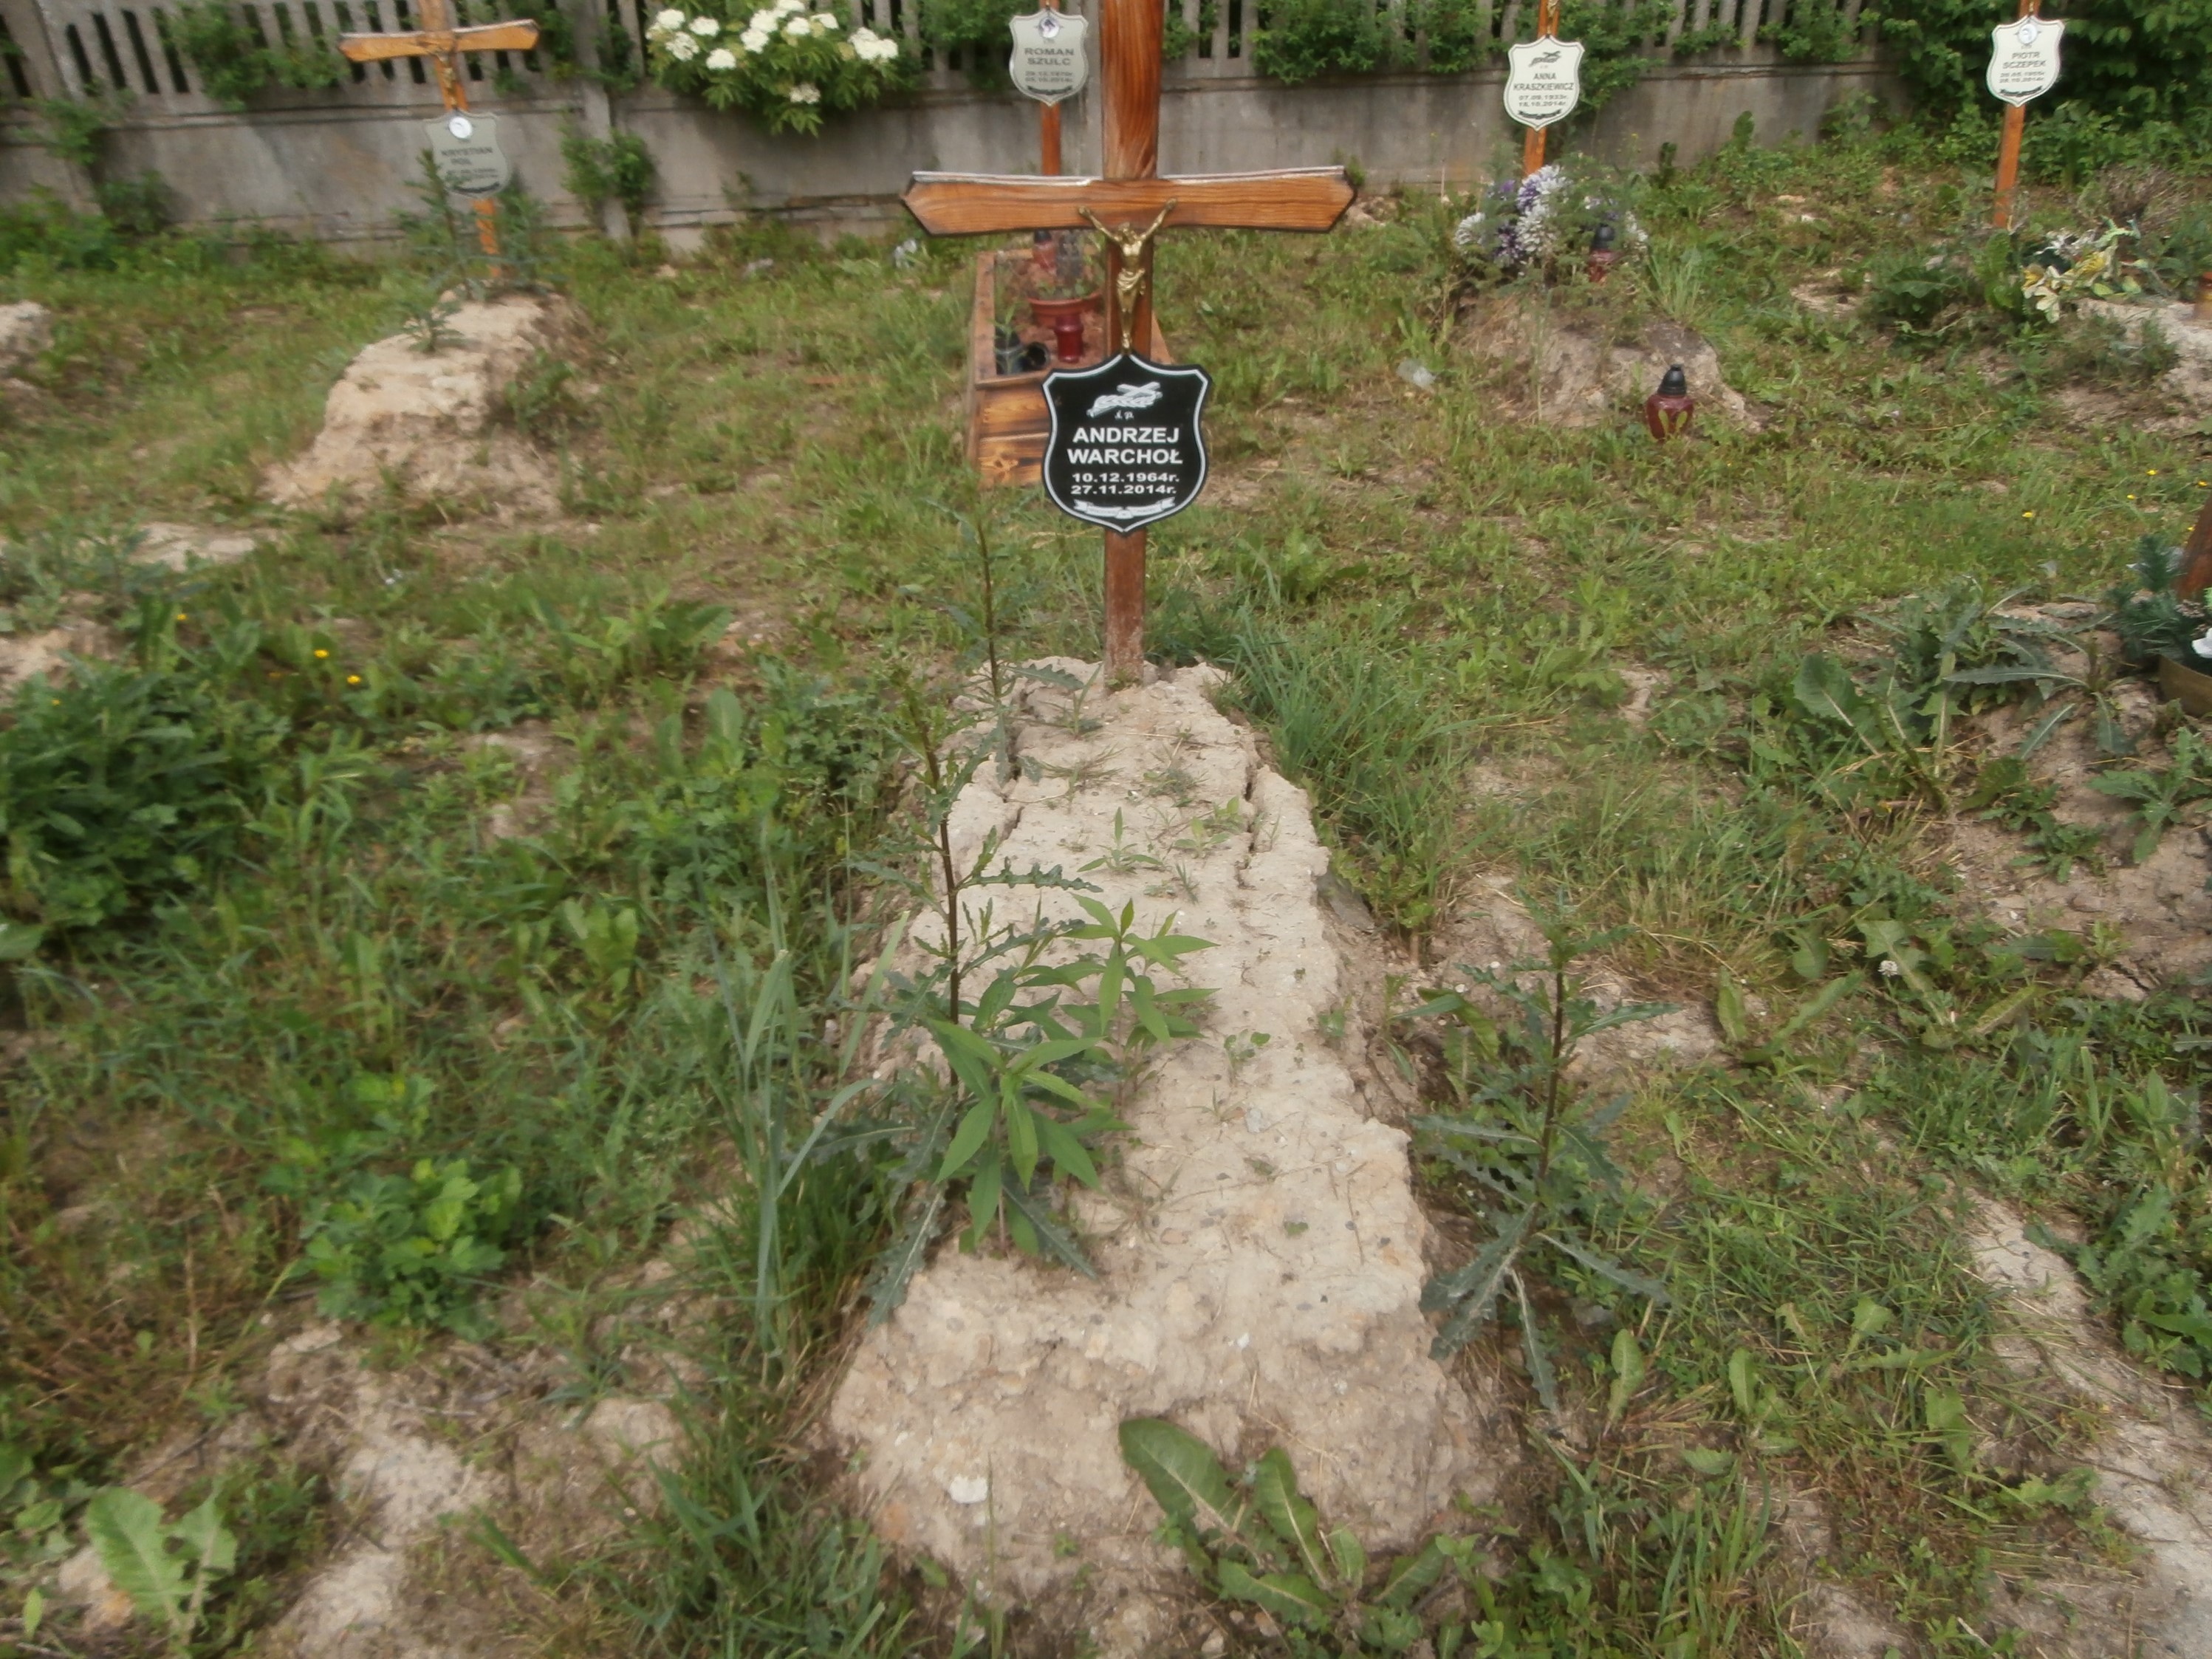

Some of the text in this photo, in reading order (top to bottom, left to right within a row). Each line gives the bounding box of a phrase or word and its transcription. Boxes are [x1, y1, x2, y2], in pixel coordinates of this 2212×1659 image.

[1024, 47, 1074, 55] ROMAN
[1027, 58, 1071, 66] SZULC
[2002, 60, 2047, 69] SCZEPEK
[1072, 427, 1179, 443] ANDRZEJ
[1067, 448, 1183, 465] WARCHOŁ
[1072, 473, 1179, 482] 10.12.1964r.
[1071, 485, 1177, 494] 27.11.2014r.
